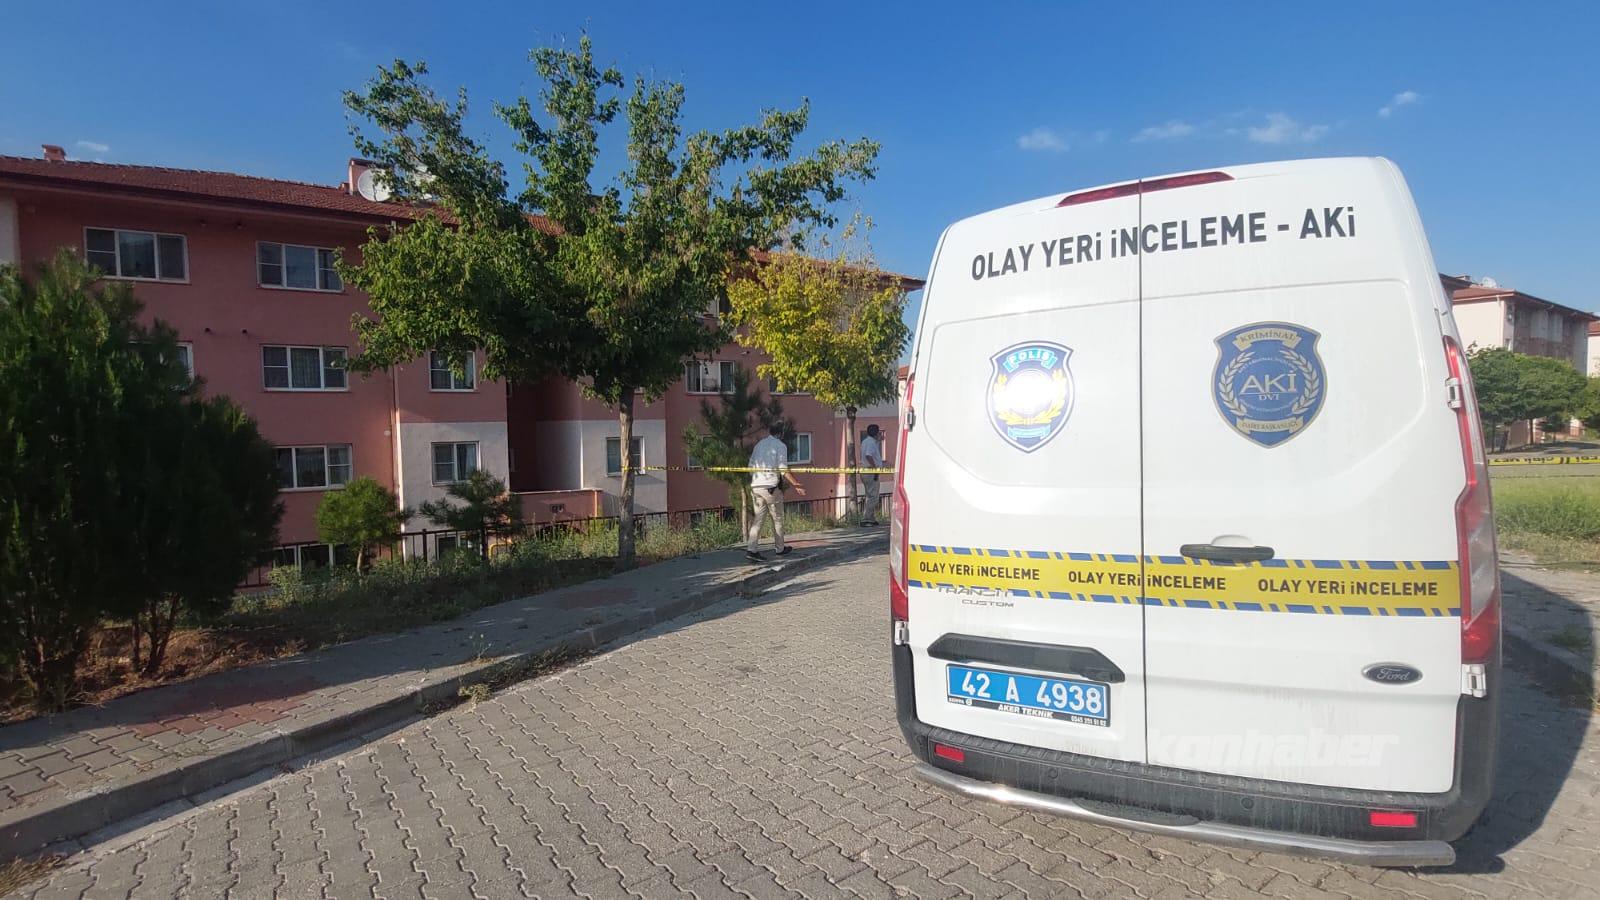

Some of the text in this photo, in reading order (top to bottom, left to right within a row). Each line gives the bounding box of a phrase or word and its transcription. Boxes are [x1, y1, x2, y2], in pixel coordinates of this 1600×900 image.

[971, 243, 1034, 281] OLAY
[919, 561, 946, 574] OLAY
[1068, 570, 1104, 584] OLAY
[936, 585, 1014, 598] TRANSIT
[1258, 578, 1302, 593] OLAY
[961, 599, 1014, 608] CUSTOM
[1376, 667, 1409, 682] Ford
[962, 671, 1102, 714] 42 A 4938
[998, 704, 1020, 714] AKER
